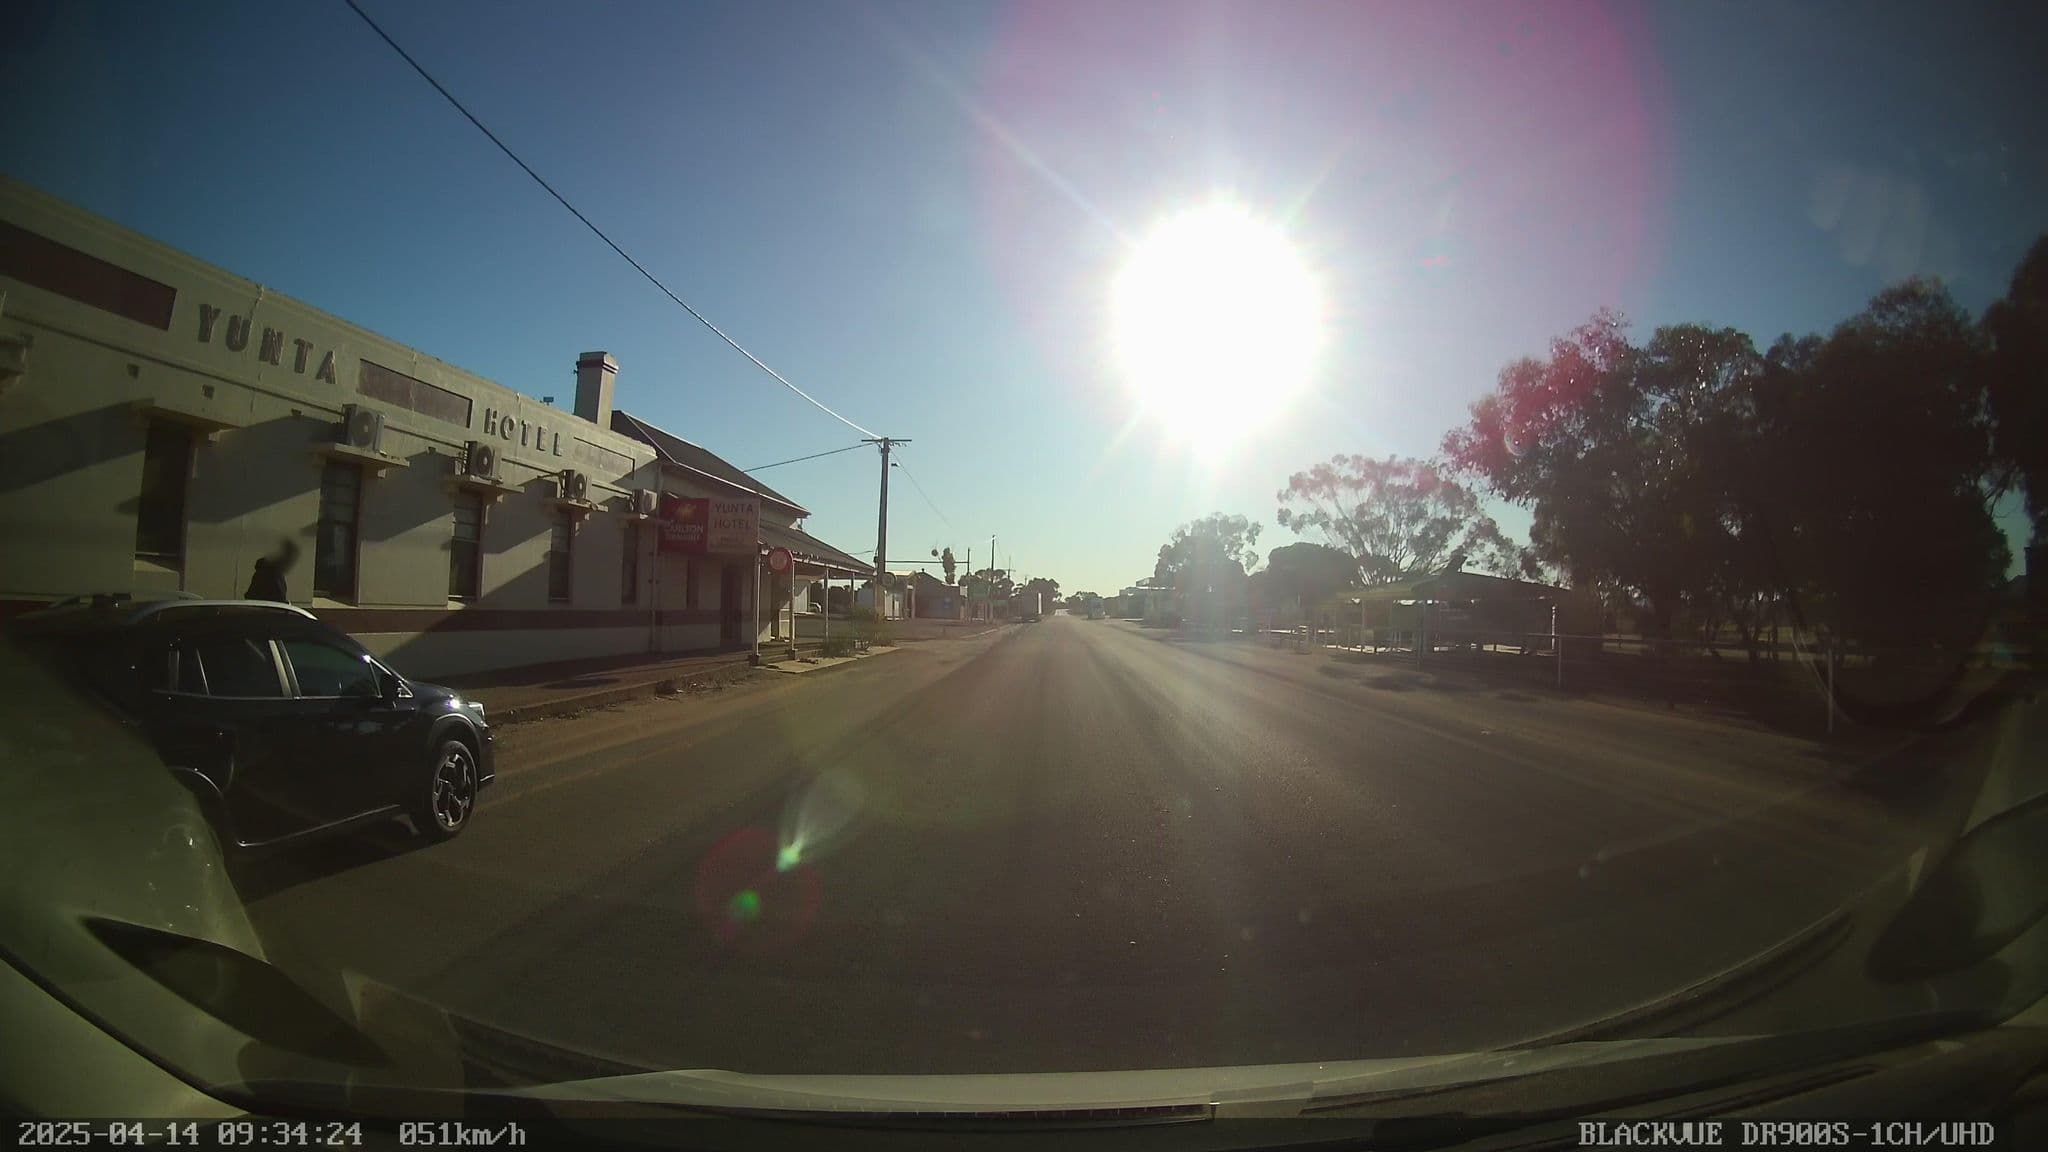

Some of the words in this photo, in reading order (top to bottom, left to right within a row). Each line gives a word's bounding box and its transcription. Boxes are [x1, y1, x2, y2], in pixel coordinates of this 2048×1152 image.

[198, 303, 337, 385] YUNTA
[484, 407, 564, 457] HOTEL
[714, 503, 753, 513] YUNTA
[713, 519, 752, 529] HOTEL
